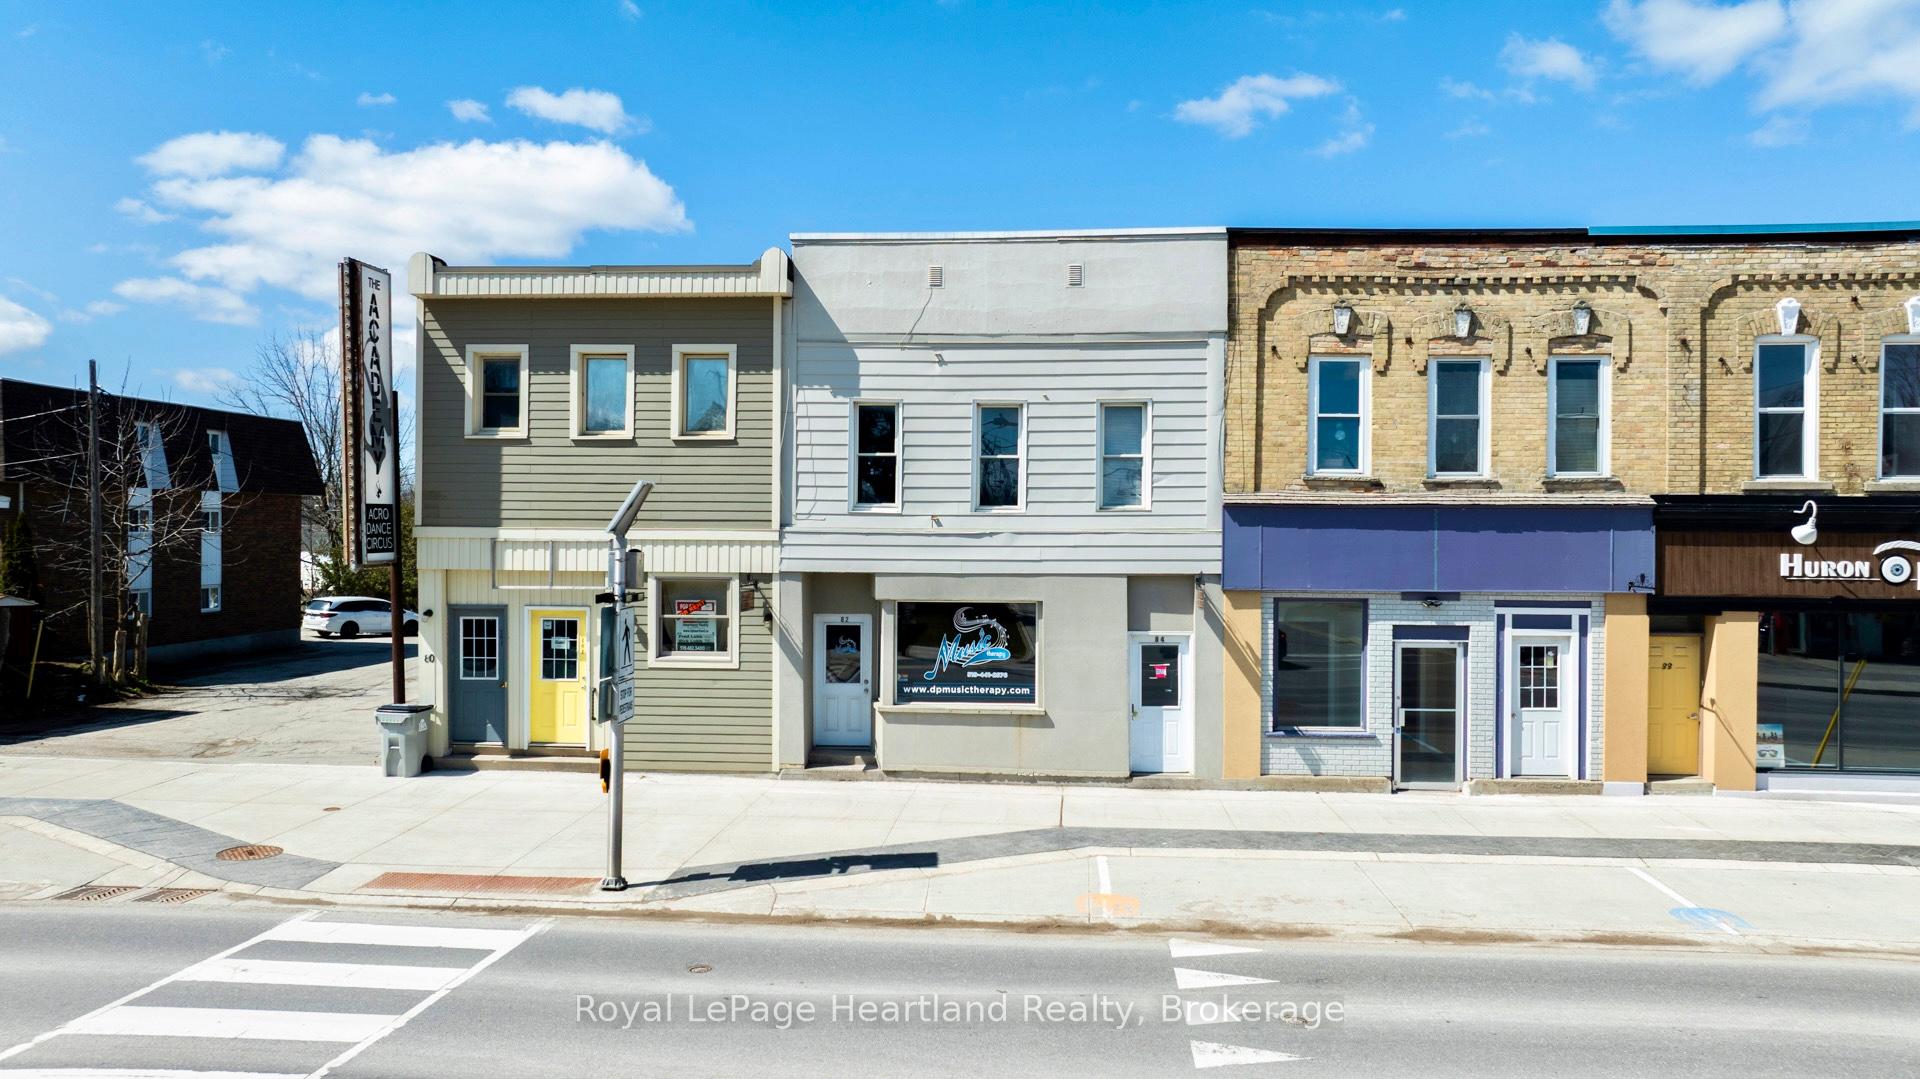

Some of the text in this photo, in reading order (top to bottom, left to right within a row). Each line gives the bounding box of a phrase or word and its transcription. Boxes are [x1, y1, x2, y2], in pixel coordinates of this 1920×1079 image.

[368, 277, 381, 291] THE
[368, 293, 385, 475] ACADEMY
[368, 507, 390, 520] ACRO
[366, 522, 392, 535] DANCE
[366, 536, 393, 550] CIRCUS
[924, 627, 992, 680] Music
[986, 650, 1006, 659] therapy
[903, 684, 1030, 696] www.dpmusictherapy.com
